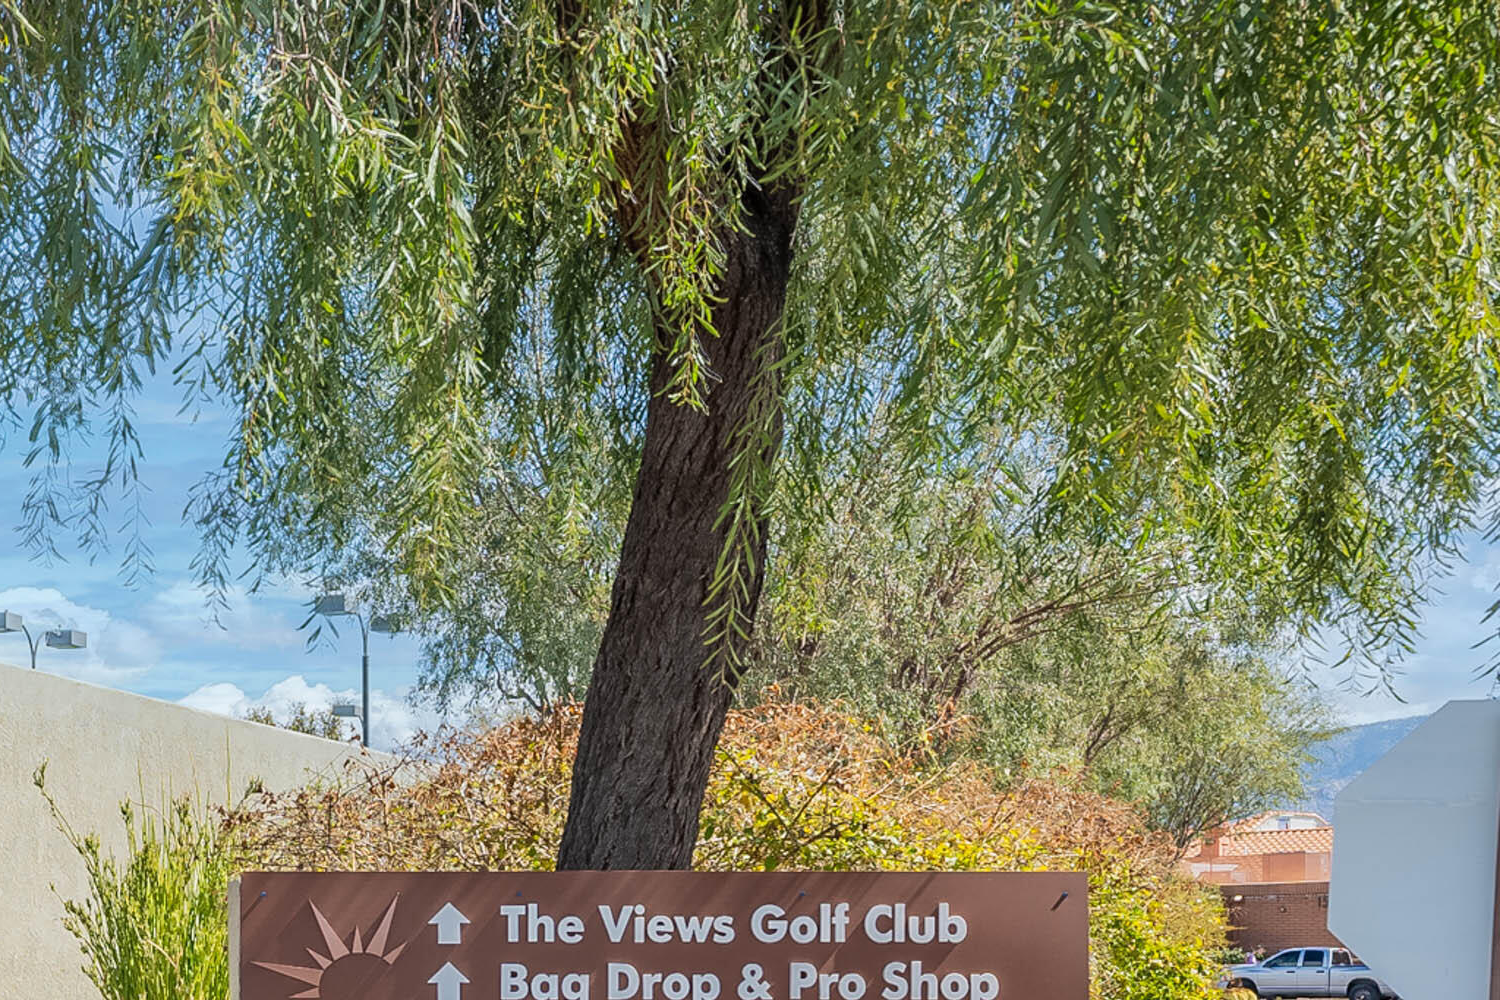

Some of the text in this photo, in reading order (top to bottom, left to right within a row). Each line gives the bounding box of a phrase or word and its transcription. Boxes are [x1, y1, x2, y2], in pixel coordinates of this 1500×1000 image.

[500, 902, 967, 943] The Views Golf Club
[738, 964, 773, 1000] &
[790, 963, 866, 1000] Pro
